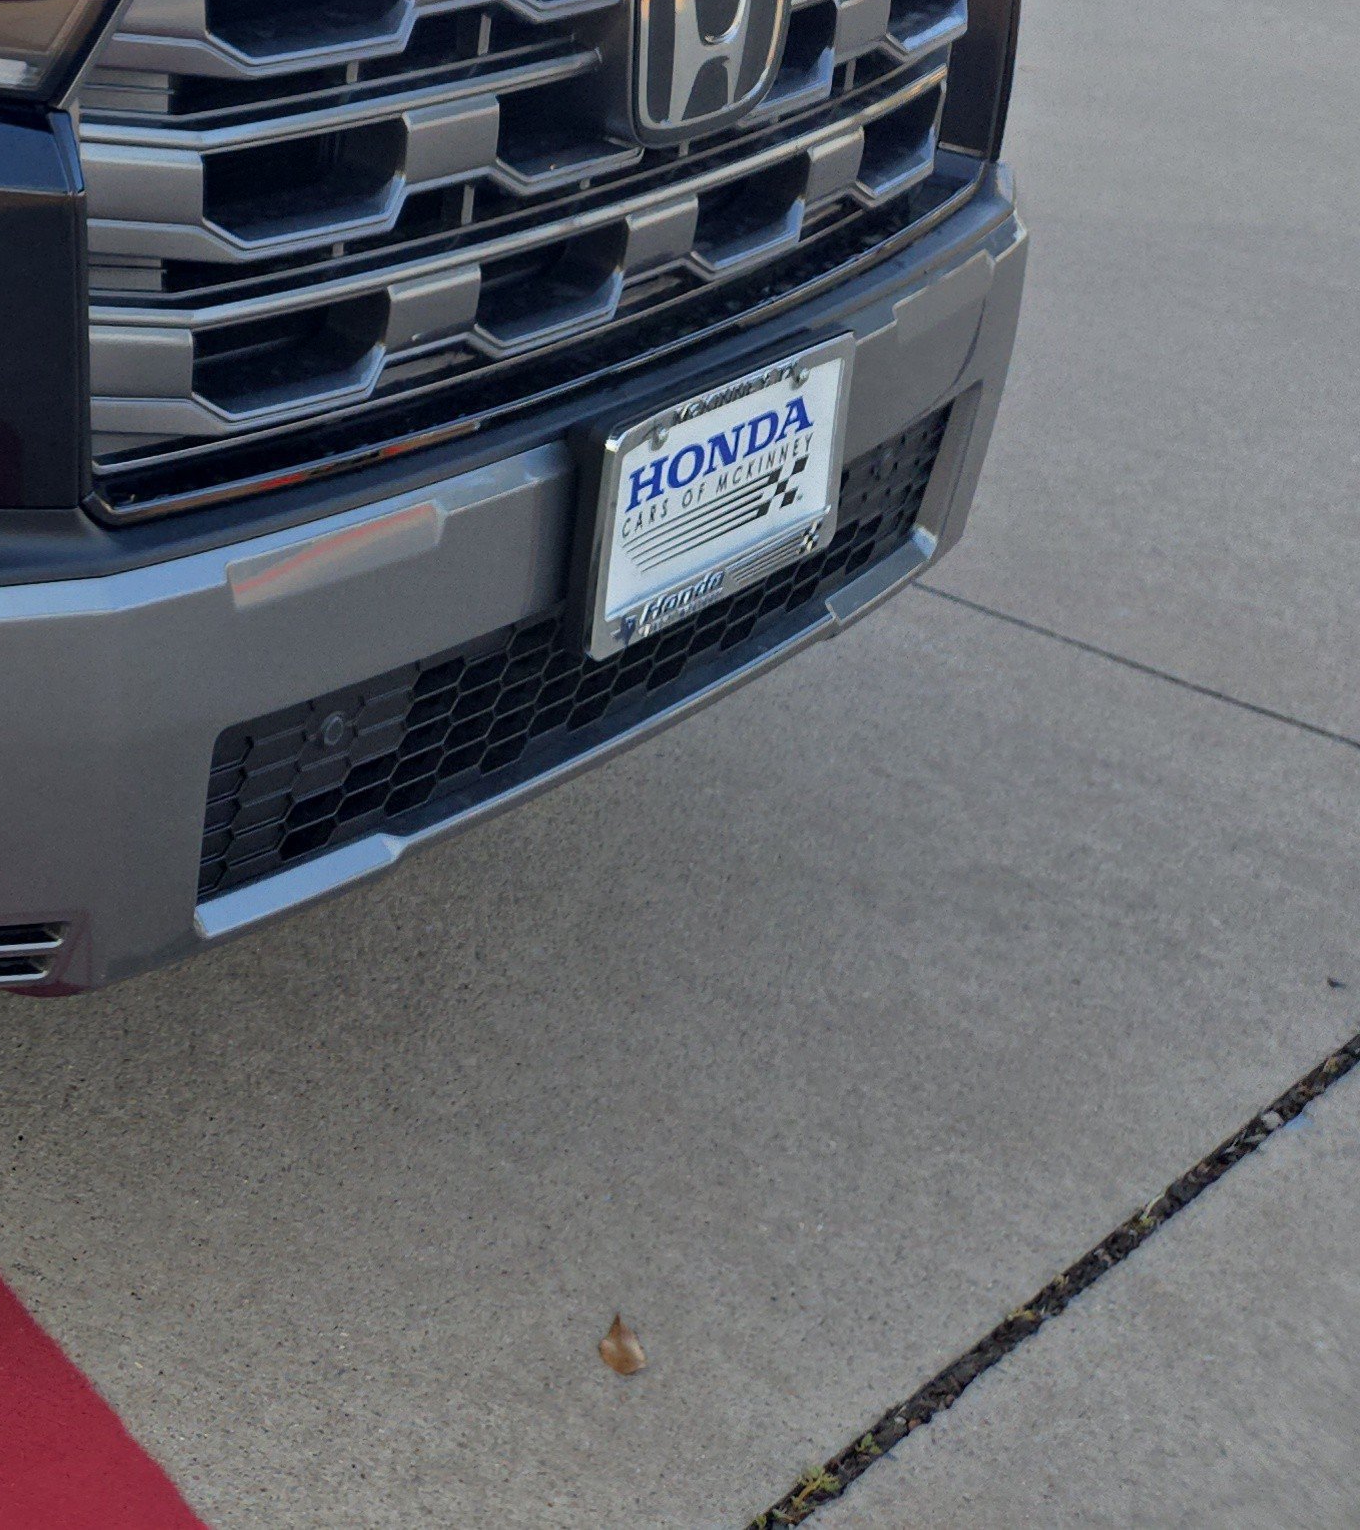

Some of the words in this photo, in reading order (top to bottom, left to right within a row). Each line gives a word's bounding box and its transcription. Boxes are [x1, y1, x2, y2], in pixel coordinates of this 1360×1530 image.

[621, 497, 669, 538] CARS
[681, 482, 706, 509] OF
[716, 432, 814, 494] MCKINNEY
[624, 395, 813, 513] HONDA
[639, 570, 726, 627] Honda
